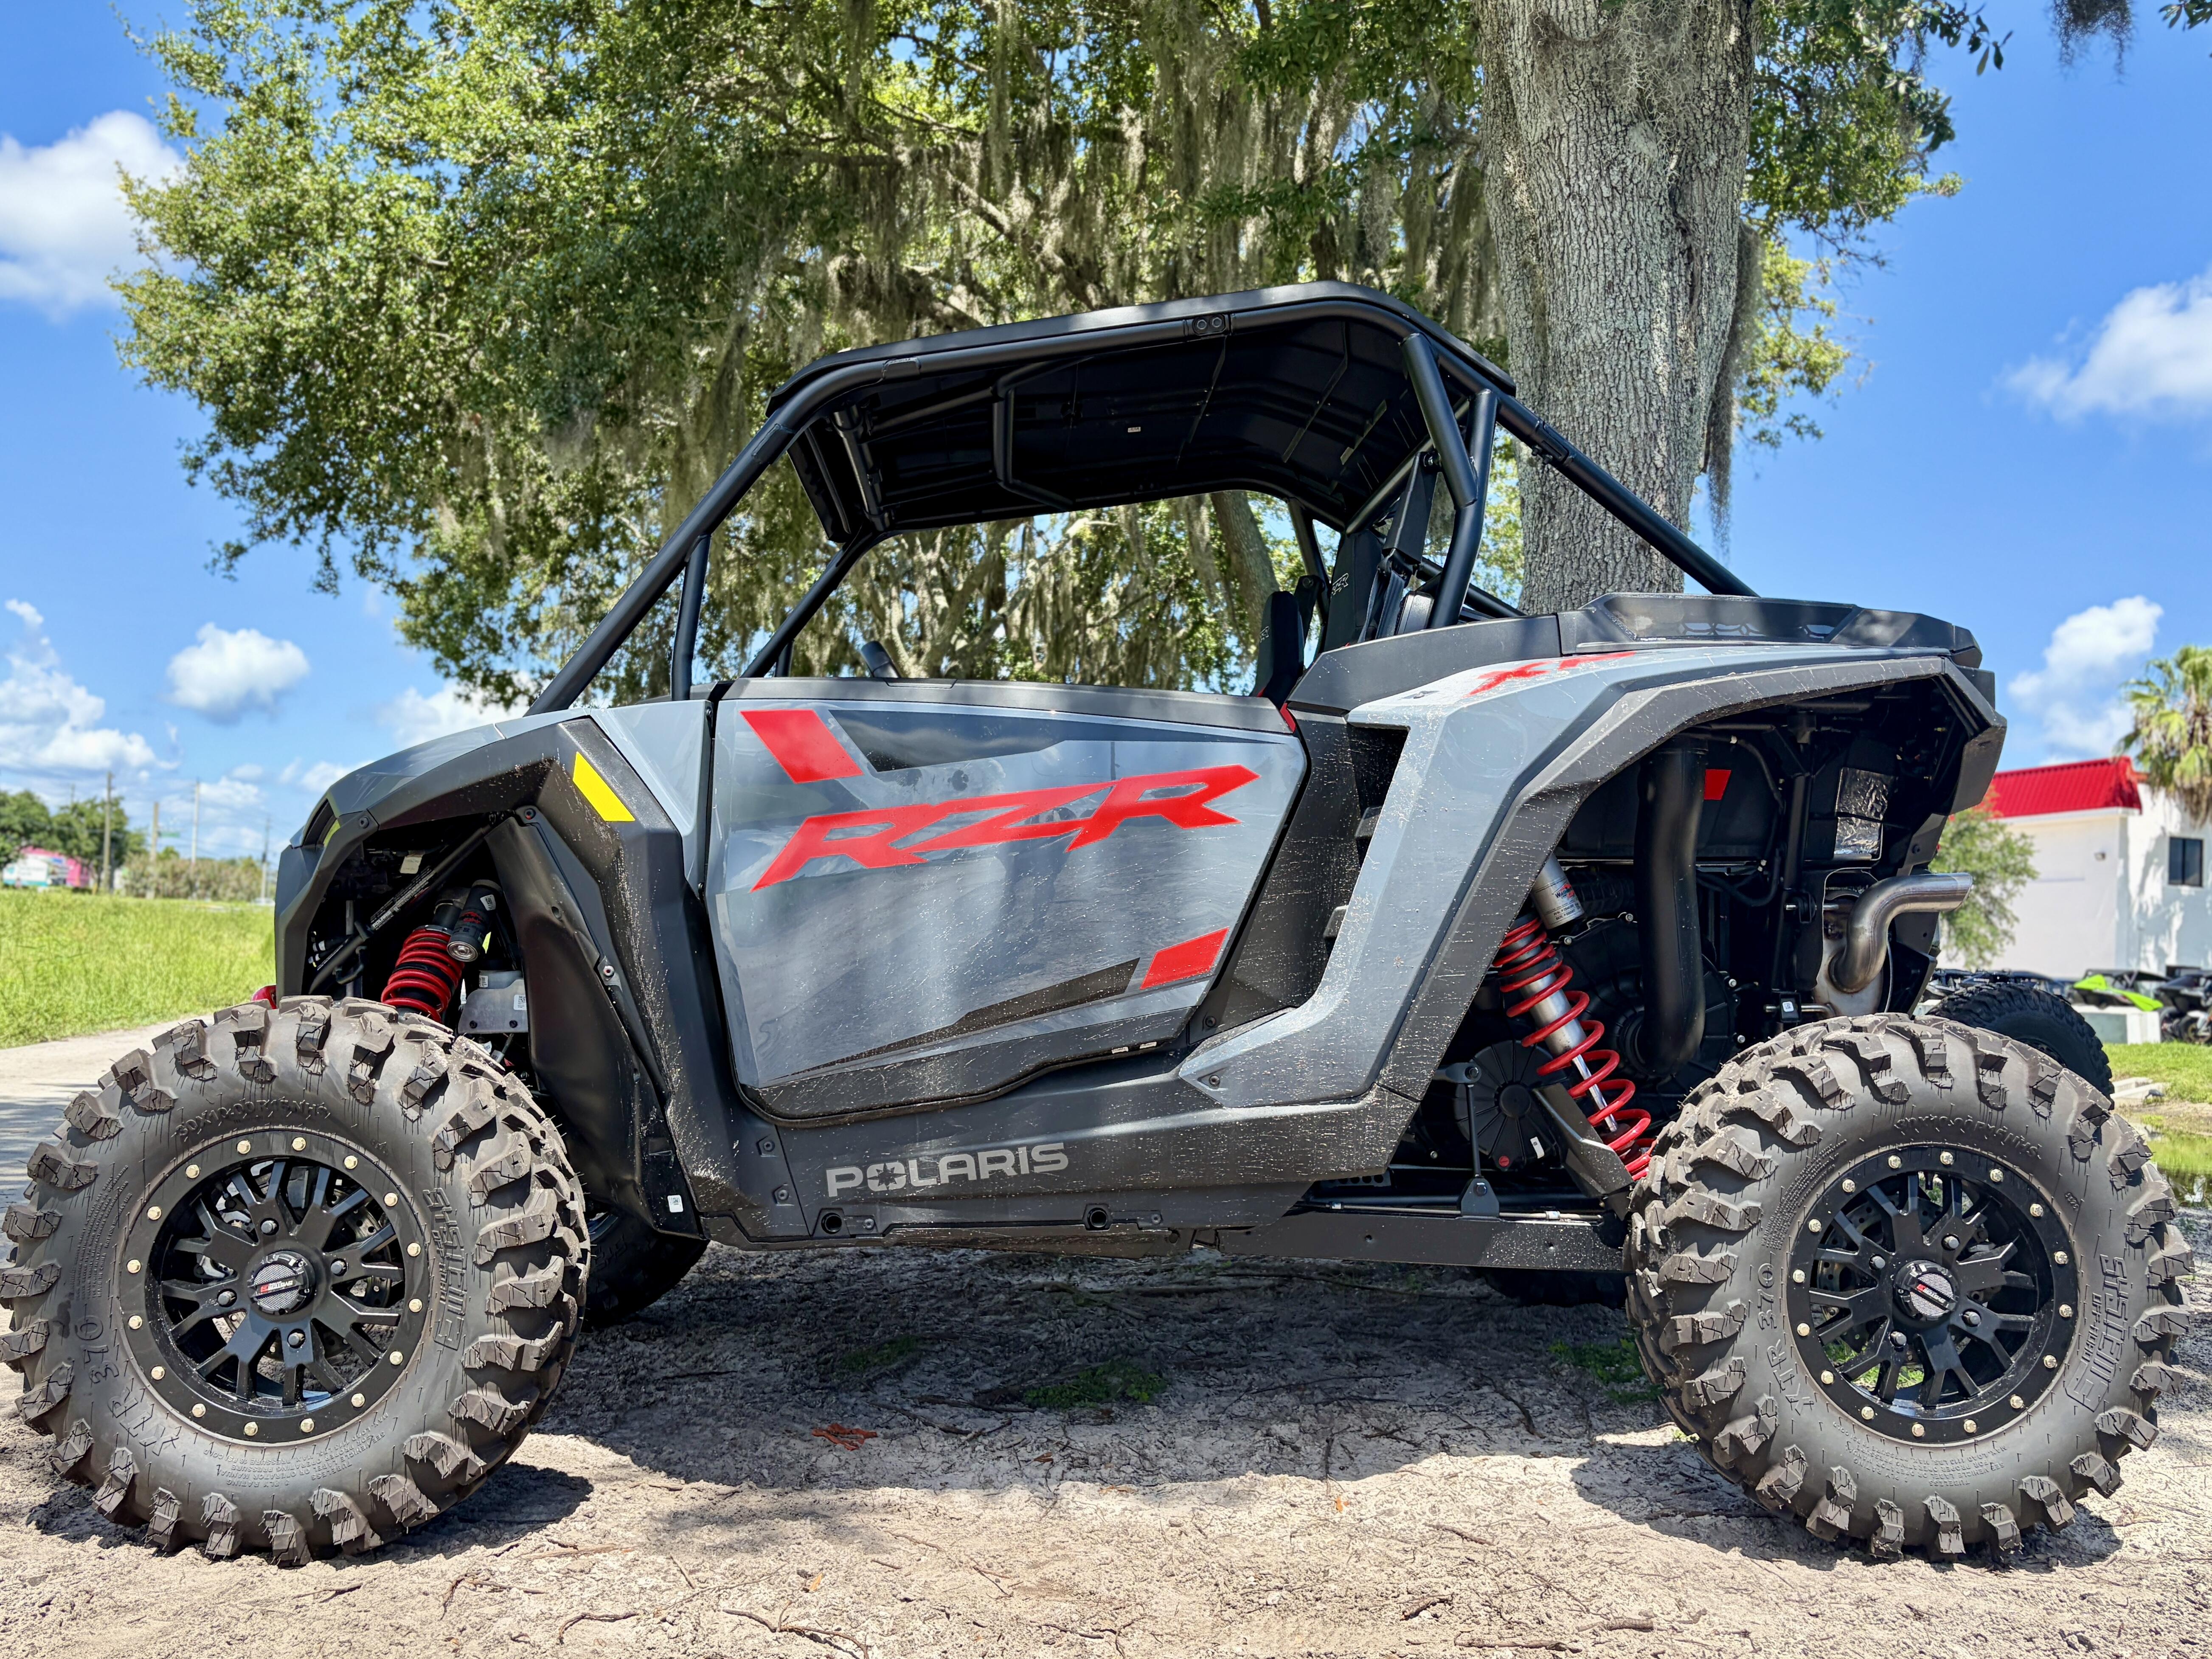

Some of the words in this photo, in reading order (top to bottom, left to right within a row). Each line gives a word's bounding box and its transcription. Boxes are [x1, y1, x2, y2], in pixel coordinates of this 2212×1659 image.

[750, 763, 1261, 892] RZR
[826, 1142, 1068, 1197] POLARIS
[1757, 1263, 1777, 1330] 370
[2090, 1254, 2128, 1382] SYSTEM
[75, 1315, 119, 1384] 370
[1767, 1339, 1814, 1415] XTR
[108, 1386, 180, 1456] XTR
[225, 1479, 259, 1487] RATING
[230, 1464, 273, 1472] PRESSURE
[310, 1460, 352, 1480] TUBELESS
[1957, 1466, 1988, 1478] VEHICLE
